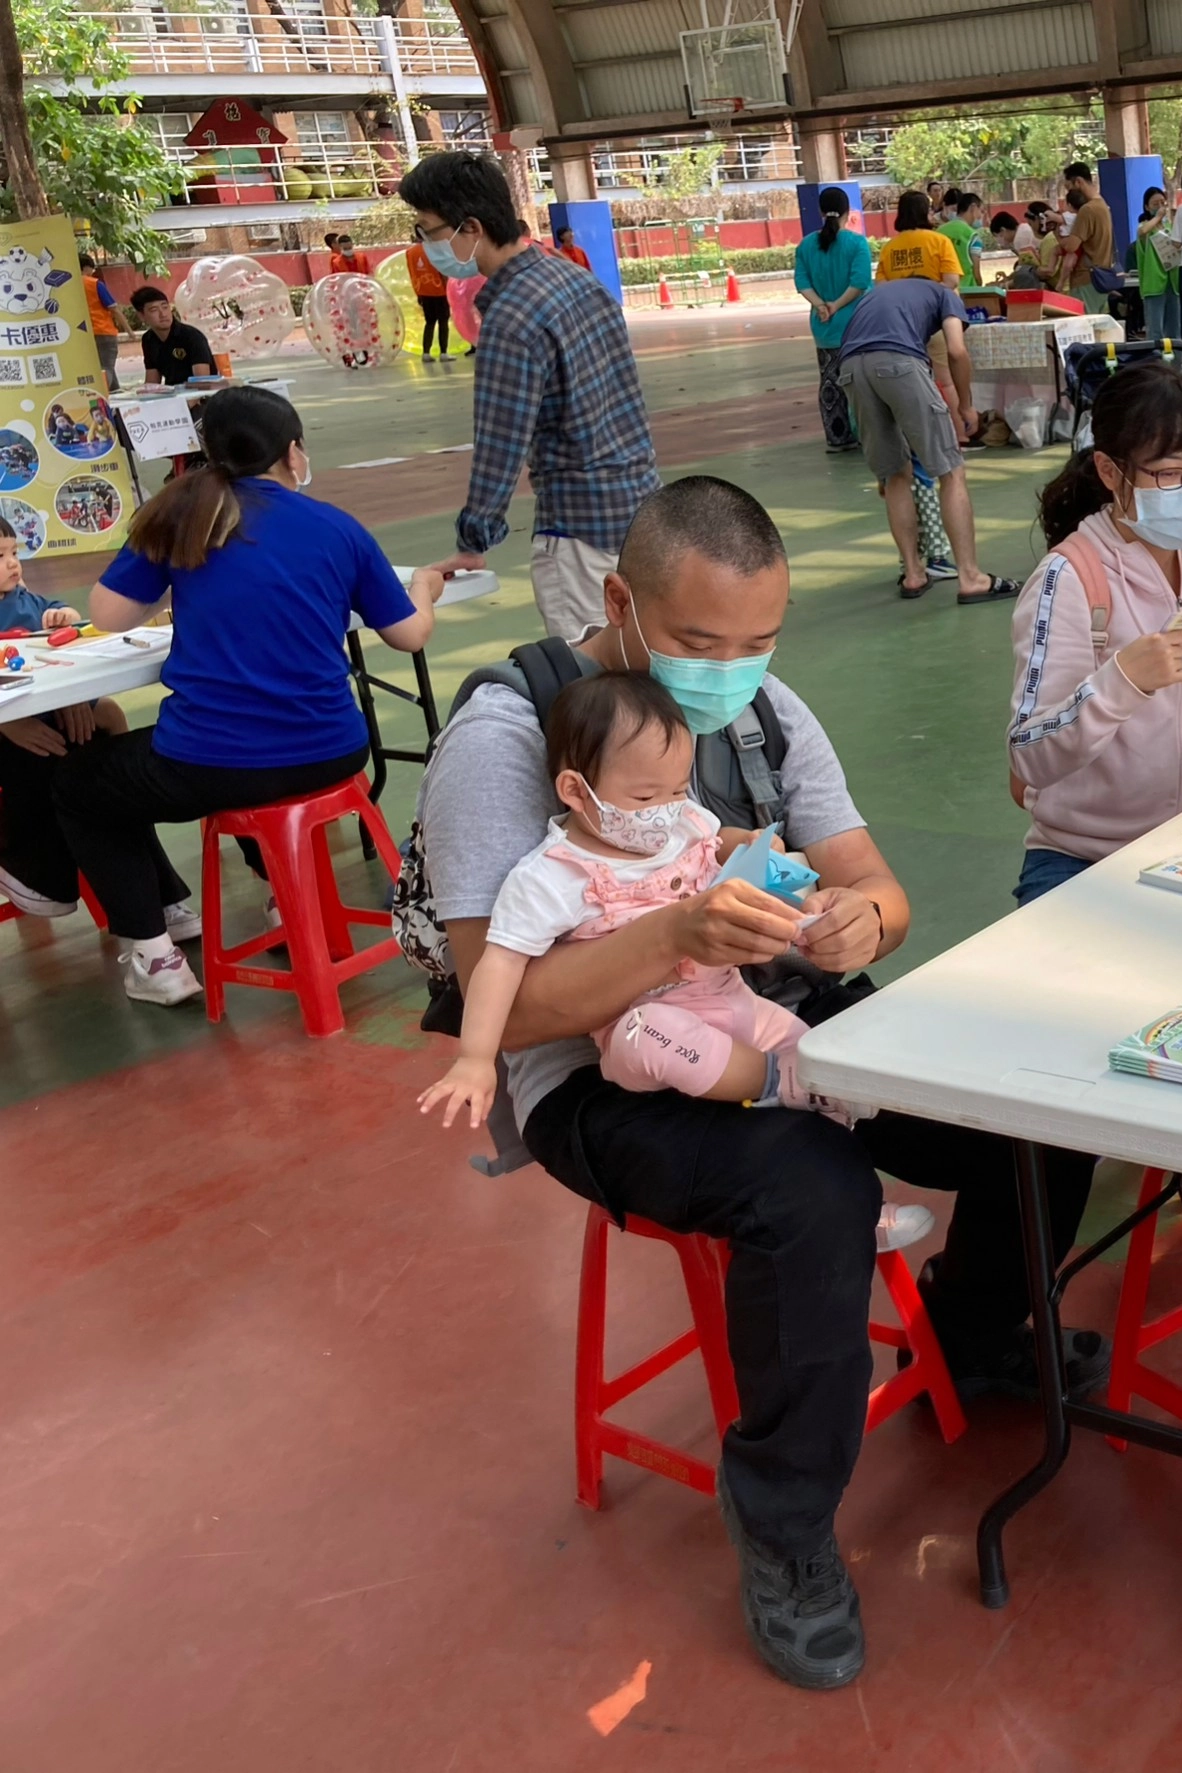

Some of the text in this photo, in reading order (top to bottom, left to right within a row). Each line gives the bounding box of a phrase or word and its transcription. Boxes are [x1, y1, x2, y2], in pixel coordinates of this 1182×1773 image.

[1, 322, 60, 346] 卡優惠
[1044, 569, 1057, 596] PUMA
[1036, 619, 1047, 646] PUMA
[1026, 667, 1040, 694] PUMA
[643, 1024, 672, 1049] bean
